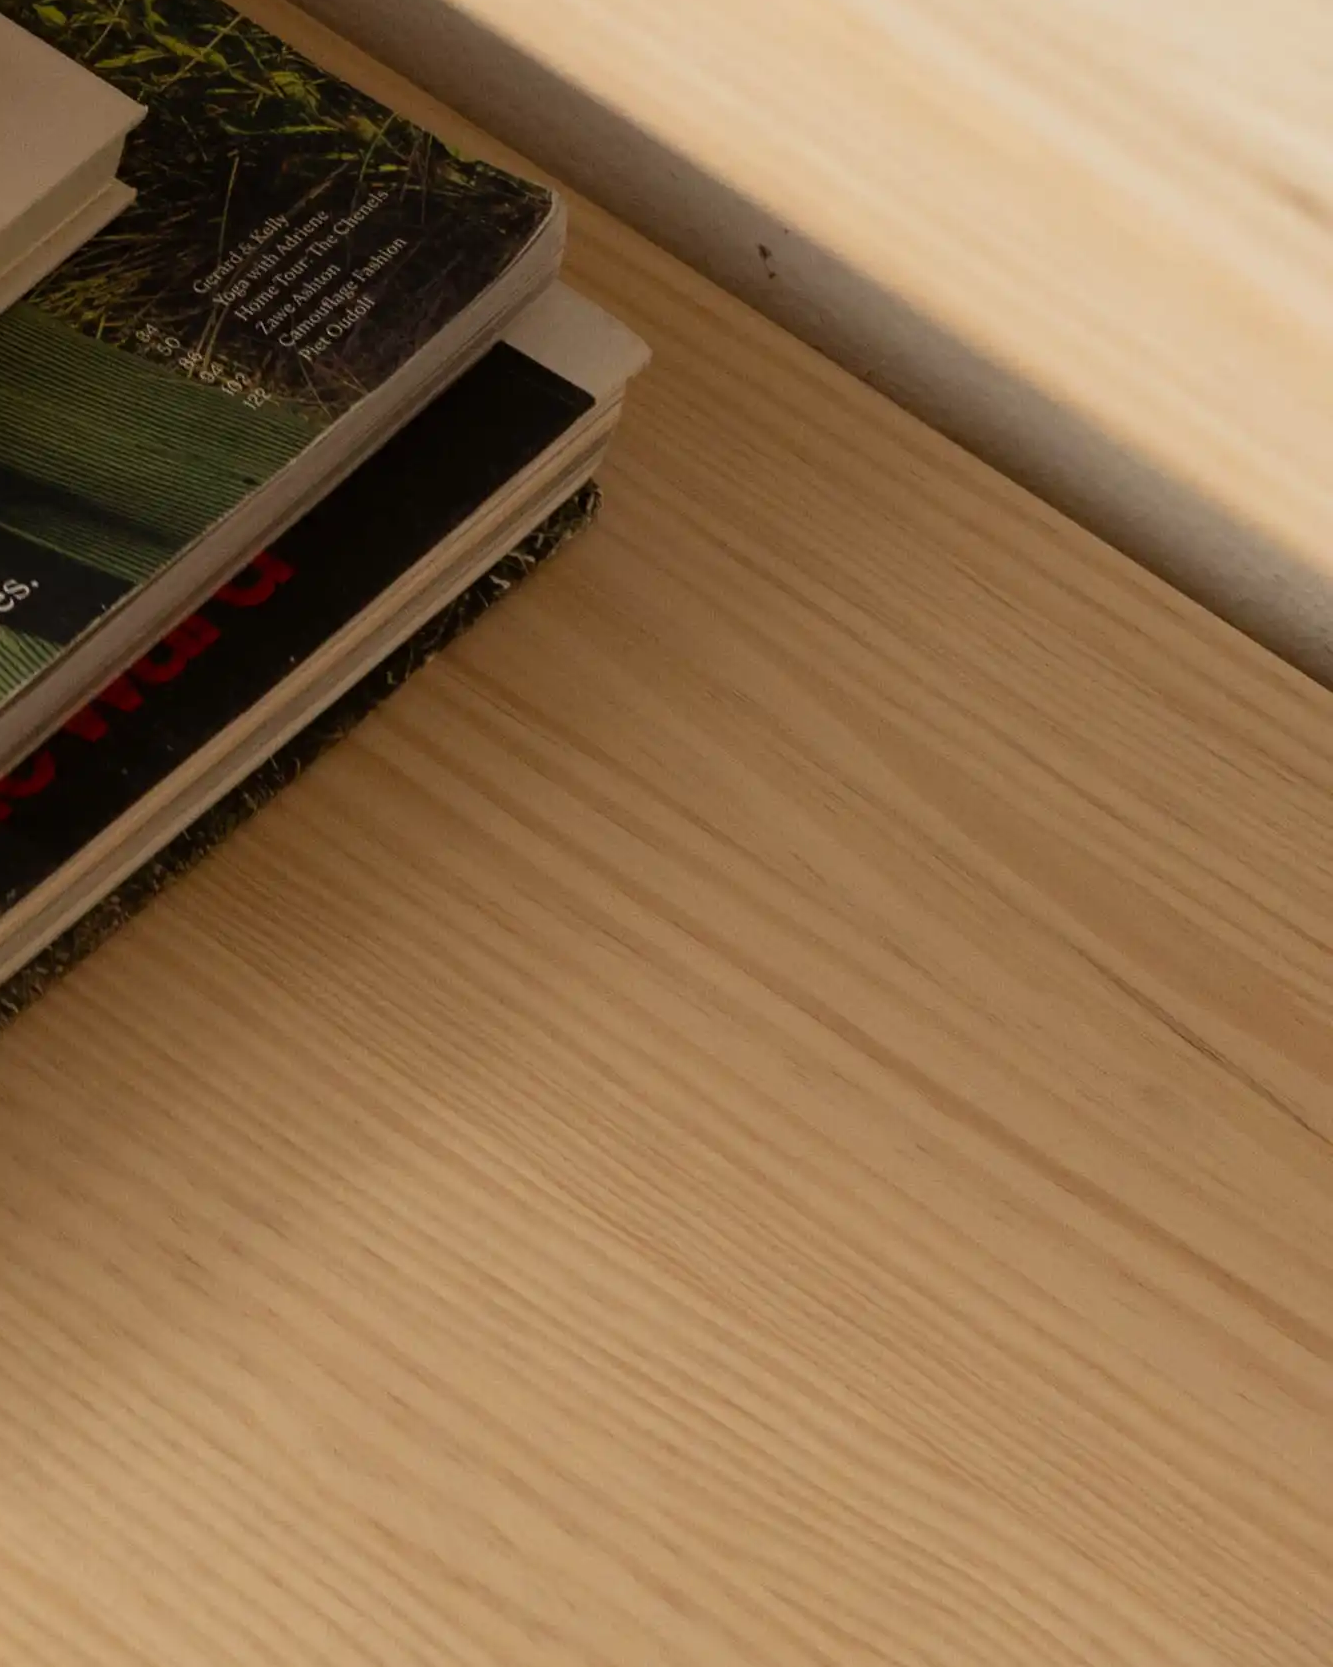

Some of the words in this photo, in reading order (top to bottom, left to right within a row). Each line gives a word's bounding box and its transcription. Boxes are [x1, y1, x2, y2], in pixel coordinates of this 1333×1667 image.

[157, 335, 181, 357] 50
[213, 278, 251, 307] Yoga
[247, 253, 281, 280] with
[276, 208, 330, 257] Adriene
[193, 249, 242, 295] Gerard
[240, 241, 254, 256] &
[249, 213, 290, 246] Kelly
[233, 285, 280, 322] Home
[308, 230, 338, 259] The
[256, 302, 297, 337] Zawe
[293, 264, 341, 309] Ashton
[278, 275, 357, 349] Camouflage
[353, 237, 408, 286] Fashion
[243, 387, 273, 411] 122
[298, 334, 330, 364] Piet
[326, 294, 377, 339] Oudolf
